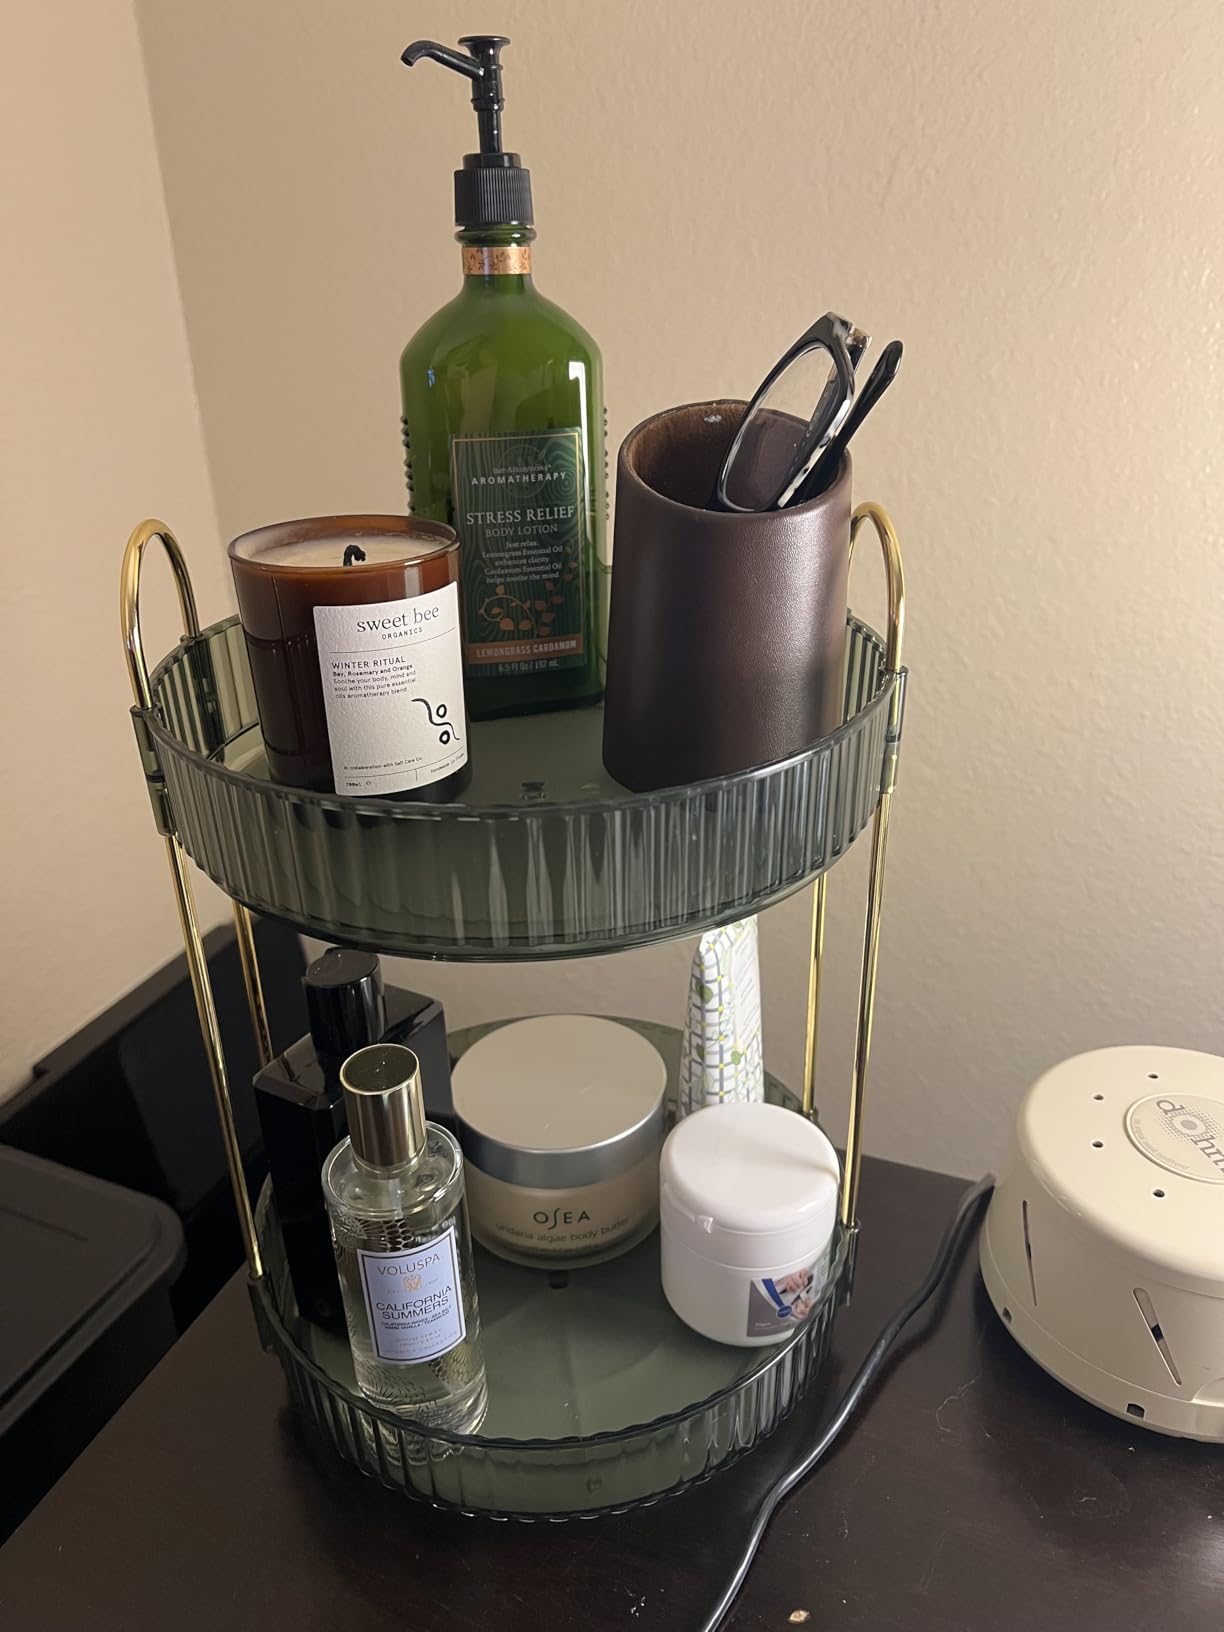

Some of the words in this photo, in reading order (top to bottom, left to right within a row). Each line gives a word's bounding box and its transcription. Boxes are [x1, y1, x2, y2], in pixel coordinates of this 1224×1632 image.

[471, 472, 567, 485] AROMATHERAPY
[466, 509, 521, 526] STRESS
[526, 506, 575, 521] RELIEF
[486, 527, 515, 537] BODY
[518, 523, 558, 535] LOTION
[482, 551, 522, 559] Lemongrass
[522, 547, 552, 555] Essential
[522, 565, 551, 573] Essential
[356, 614, 409, 633] sweet
[413, 605, 440, 623] bee
[381, 626, 423, 640] ORGANICS
[476, 645, 531, 657] LEMONGRASS
[533, 640, 577, 653] CARDAMOM
[331, 660, 370, 669] WINTER
[373, 656, 406, 667] RITUAL
[347, 669, 379, 677] Rosemary
[391, 664, 413, 672] Orange
[332, 677, 356, 685] Soothe
[376, 682, 391, 690] pure
[391, 677, 417, 686] essential
[347, 690, 390, 699] aromatherapy
[390, 687, 408, 695] blend
[533, 1207, 591, 1231] OSEA
[536, 1231, 567, 1243] algae
[570, 1227, 598, 1242] body
[376, 1252, 441, 1276] VOLUSPA
[375, 1285, 453, 1312] CALIFORNIA
[382, 1296, 449, 1320] SUMMERS
